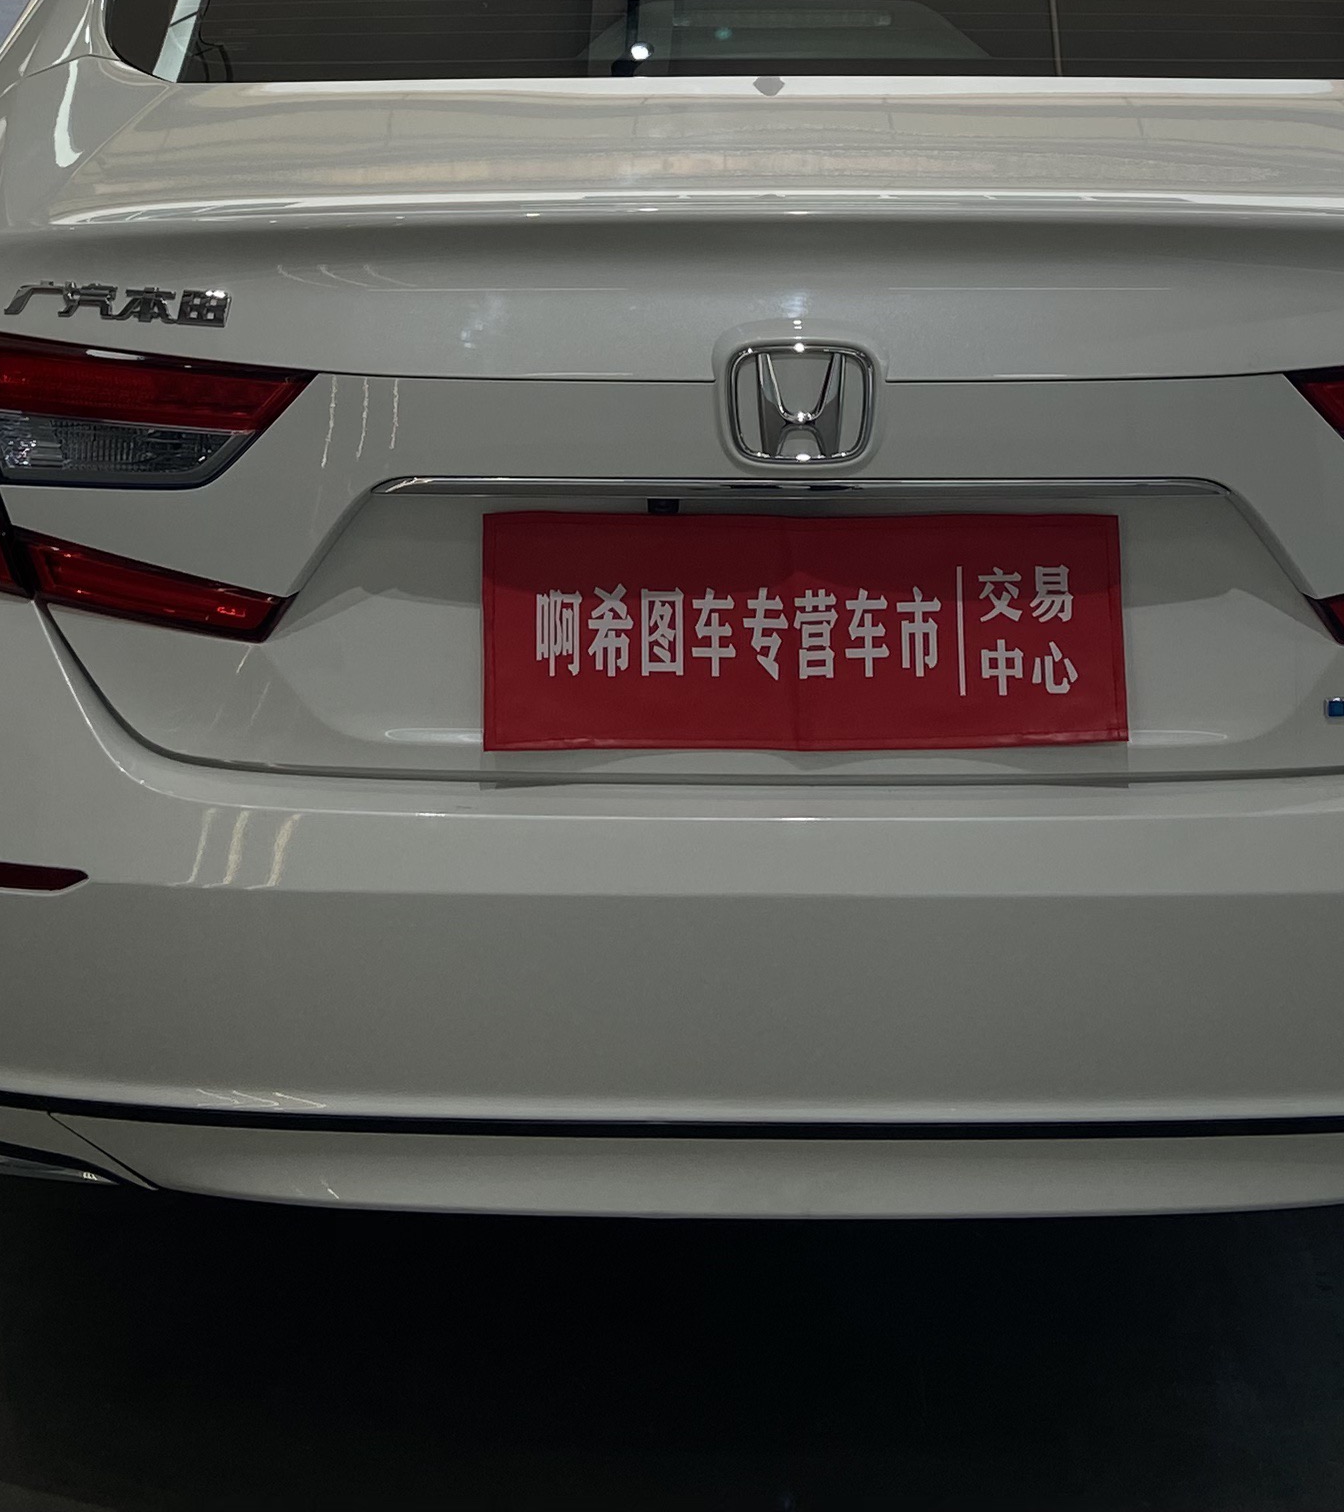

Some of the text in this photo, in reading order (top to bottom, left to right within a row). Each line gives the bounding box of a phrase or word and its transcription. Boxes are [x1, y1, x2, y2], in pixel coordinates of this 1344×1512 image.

[3, 280, 232, 328] 广汽本田
[977, 564, 1074, 624] 交易
[536, 583, 942, 680] 啊希图车专营车市
[979, 639, 1078, 697] 中心
